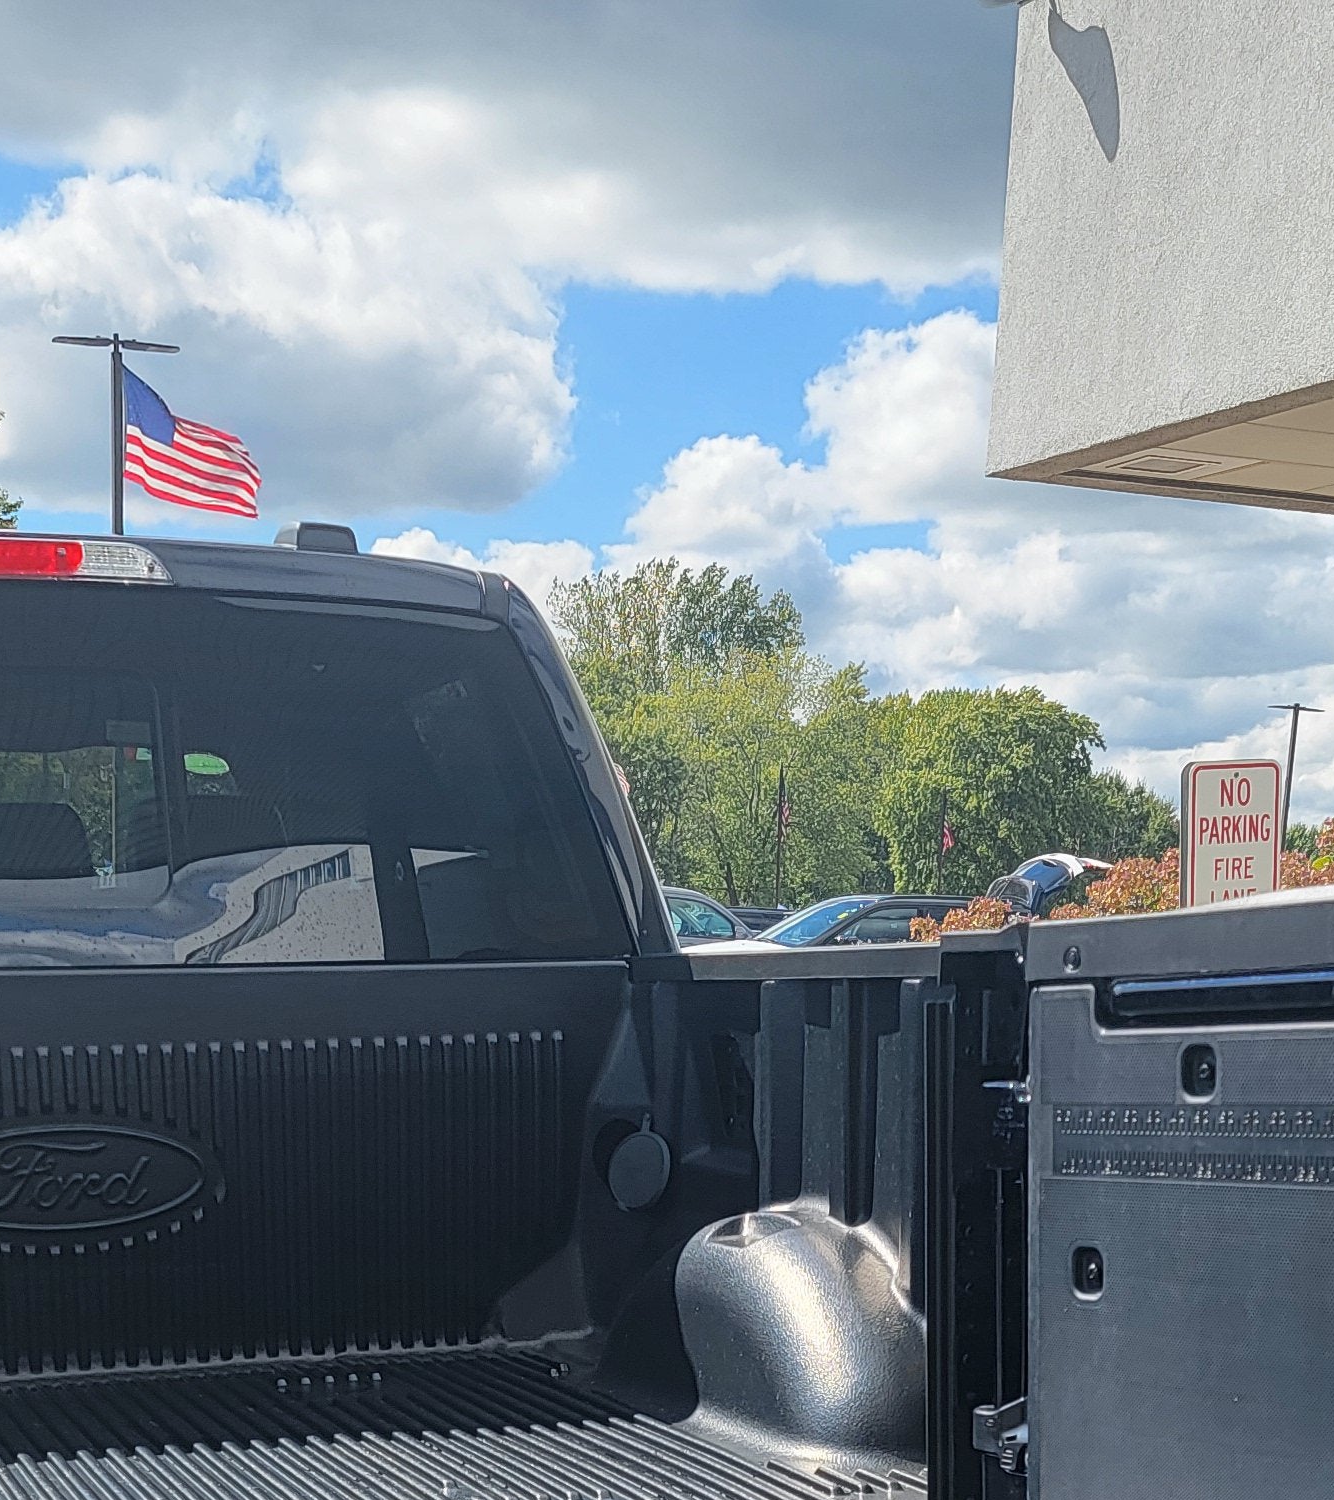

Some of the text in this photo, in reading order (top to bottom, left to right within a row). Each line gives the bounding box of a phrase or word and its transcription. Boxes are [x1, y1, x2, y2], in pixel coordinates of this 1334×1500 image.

[1220, 777, 1252, 808] NO
[1199, 813, 1271, 846] PARKING
[1214, 855, 1255, 882] FIRE
